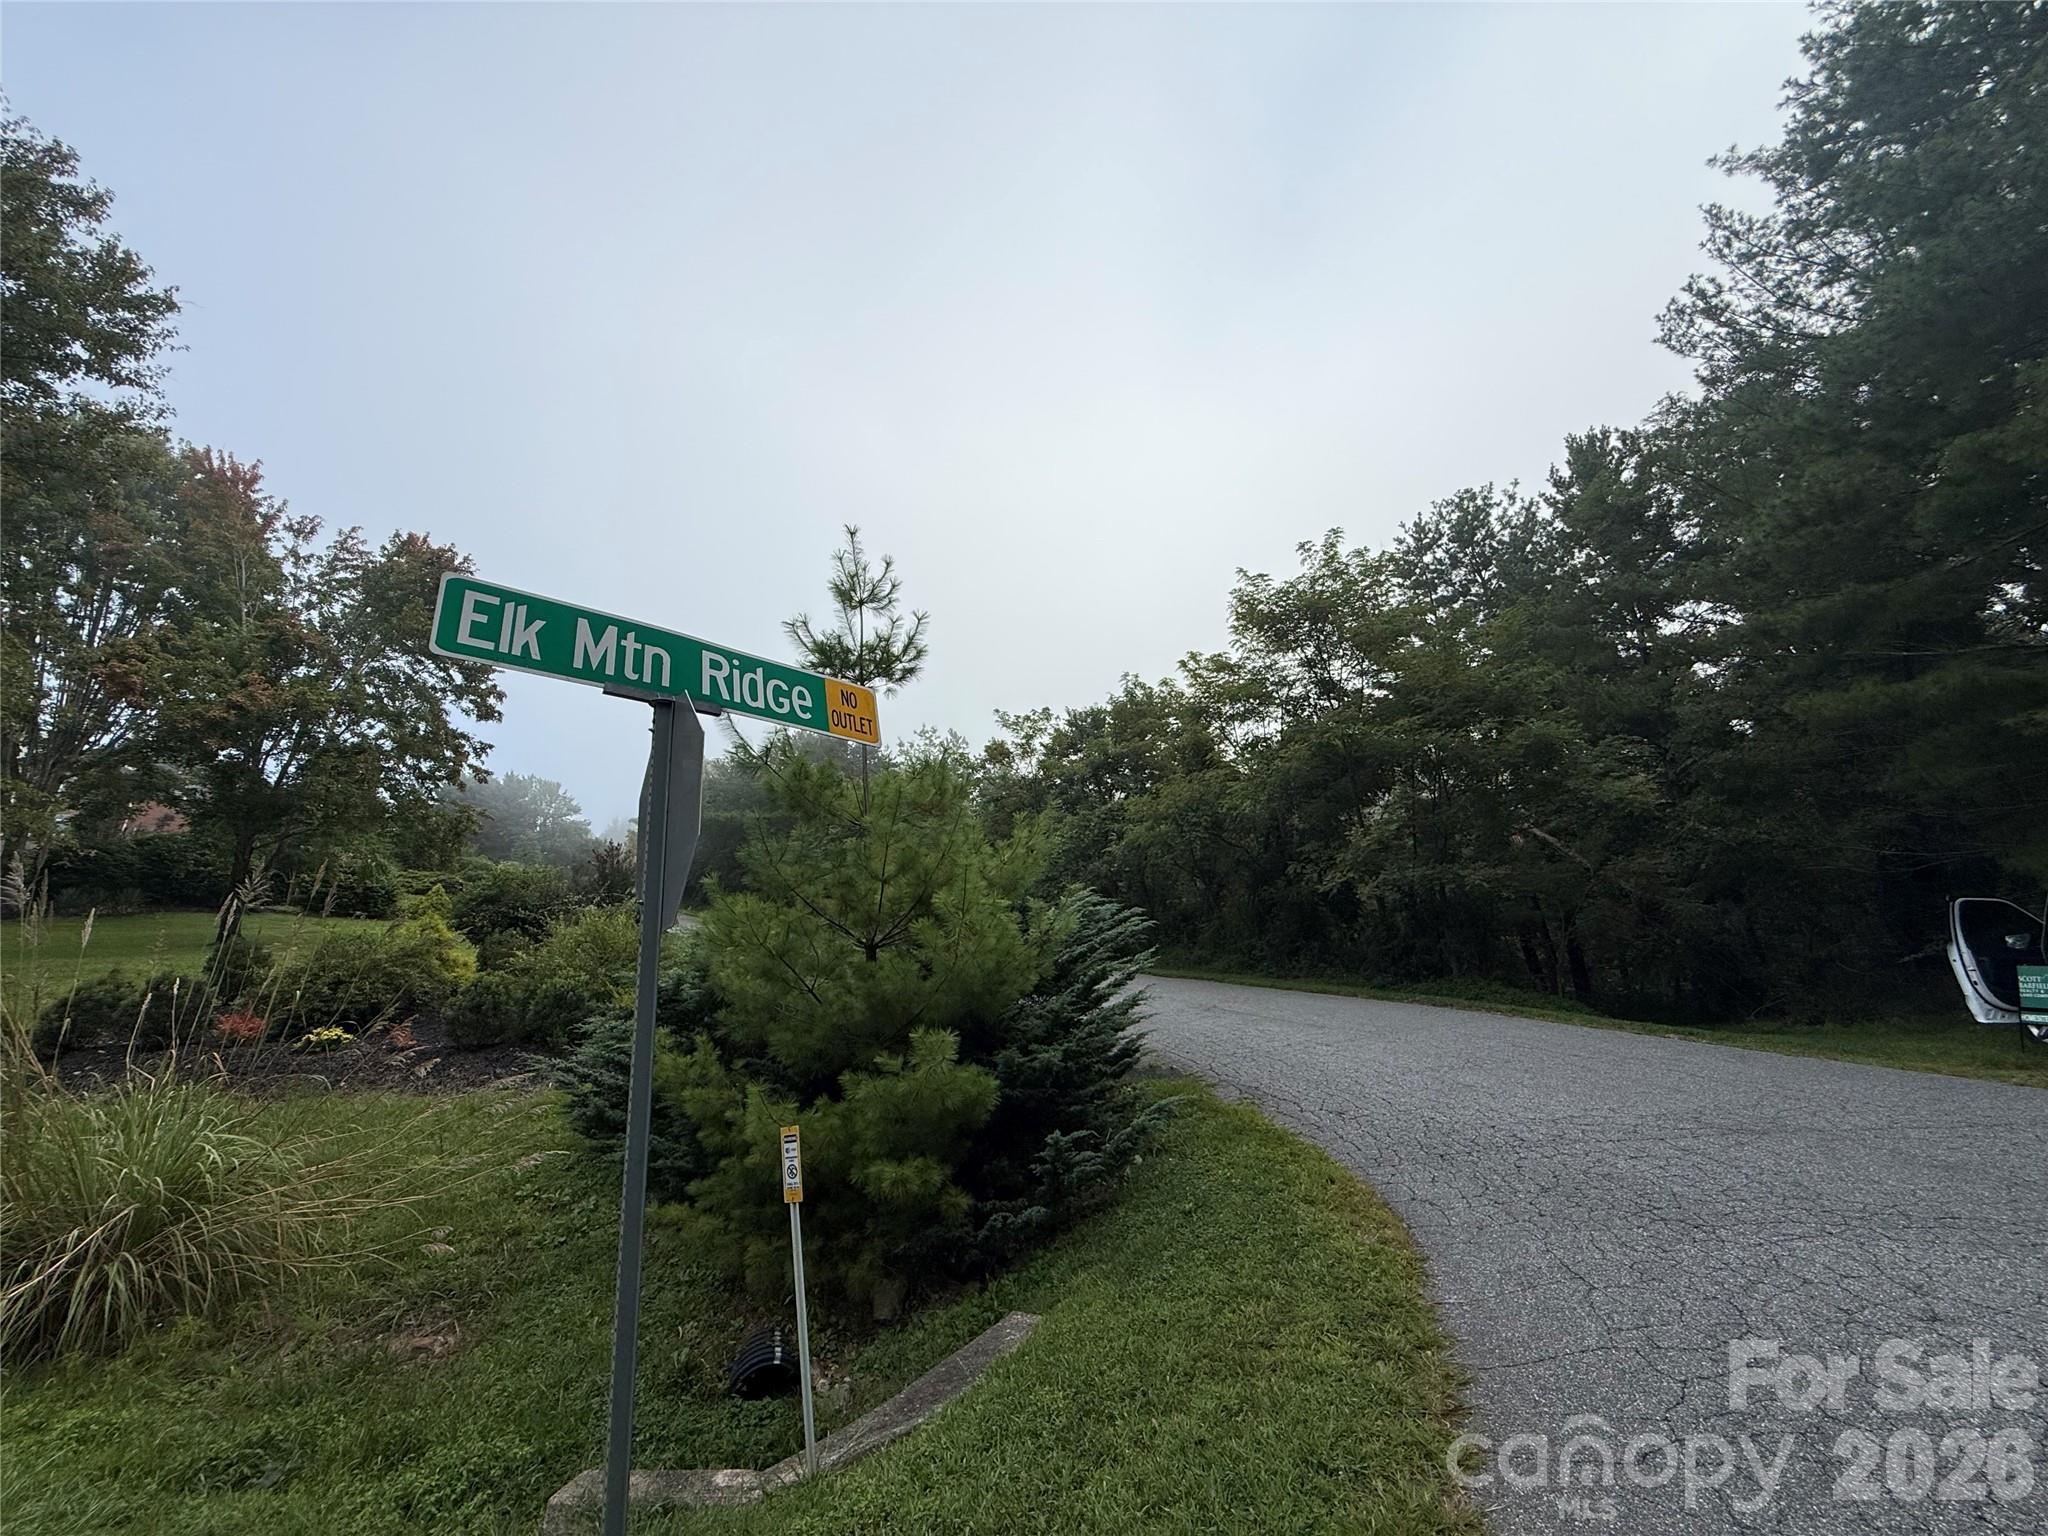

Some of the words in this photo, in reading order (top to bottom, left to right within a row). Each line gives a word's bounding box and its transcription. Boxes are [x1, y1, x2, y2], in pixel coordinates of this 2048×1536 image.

[456, 589, 546, 660] Elk
[572, 617, 671, 687] Mtn
[702, 648, 813, 720] Ridge
[840, 688, 858, 709] NO
[831, 709, 873, 736] OUTLET
